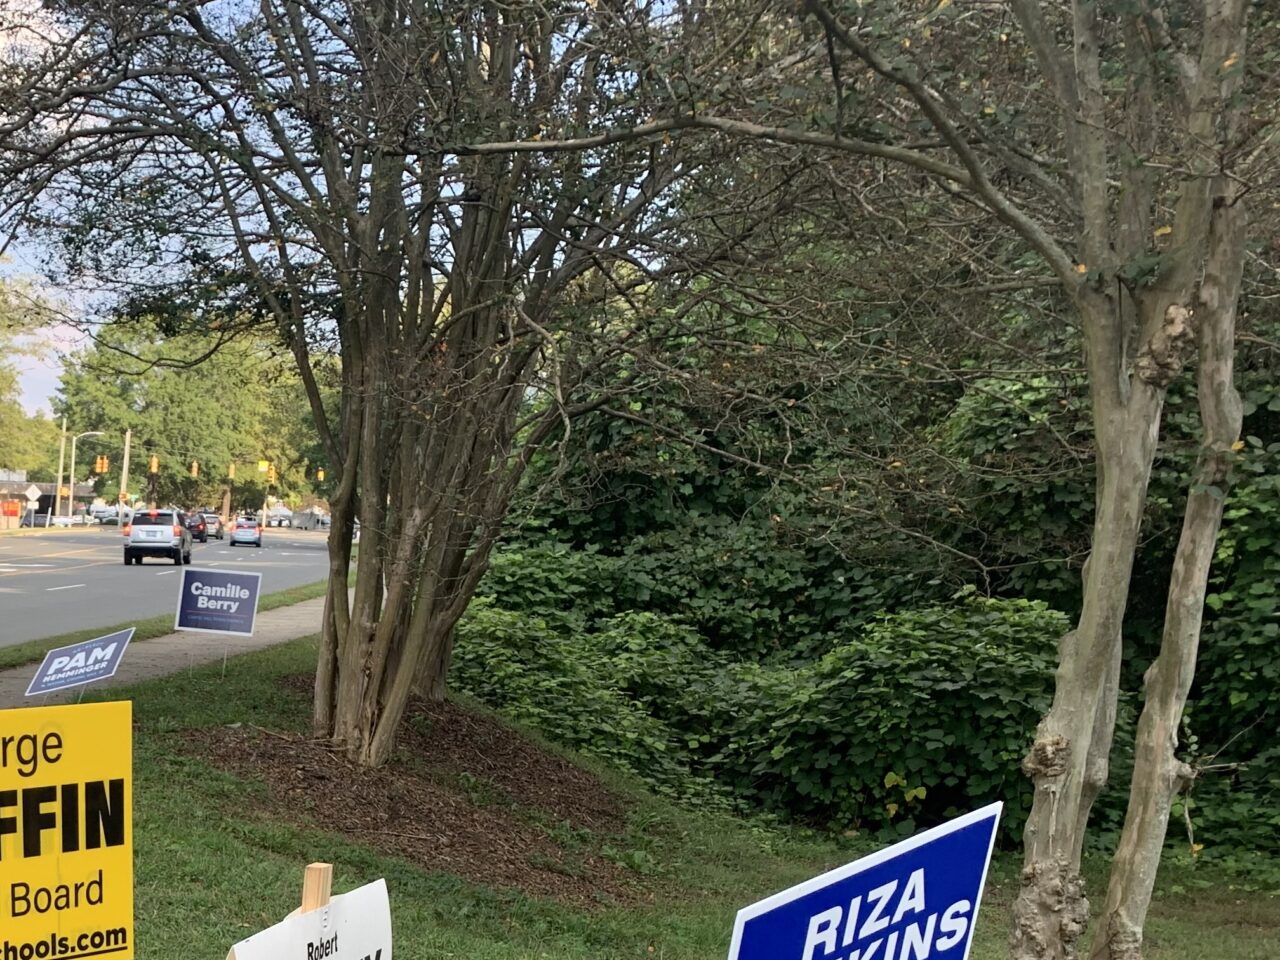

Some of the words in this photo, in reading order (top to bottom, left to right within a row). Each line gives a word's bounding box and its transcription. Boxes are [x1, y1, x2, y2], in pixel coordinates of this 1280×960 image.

[191, 582, 250, 599] Camille
[197, 596, 240, 613] Berry
[46, 642, 118, 675] PAM
[42, 661, 109, 683] HEMMINGER
[10, 869, 104, 918] Board
